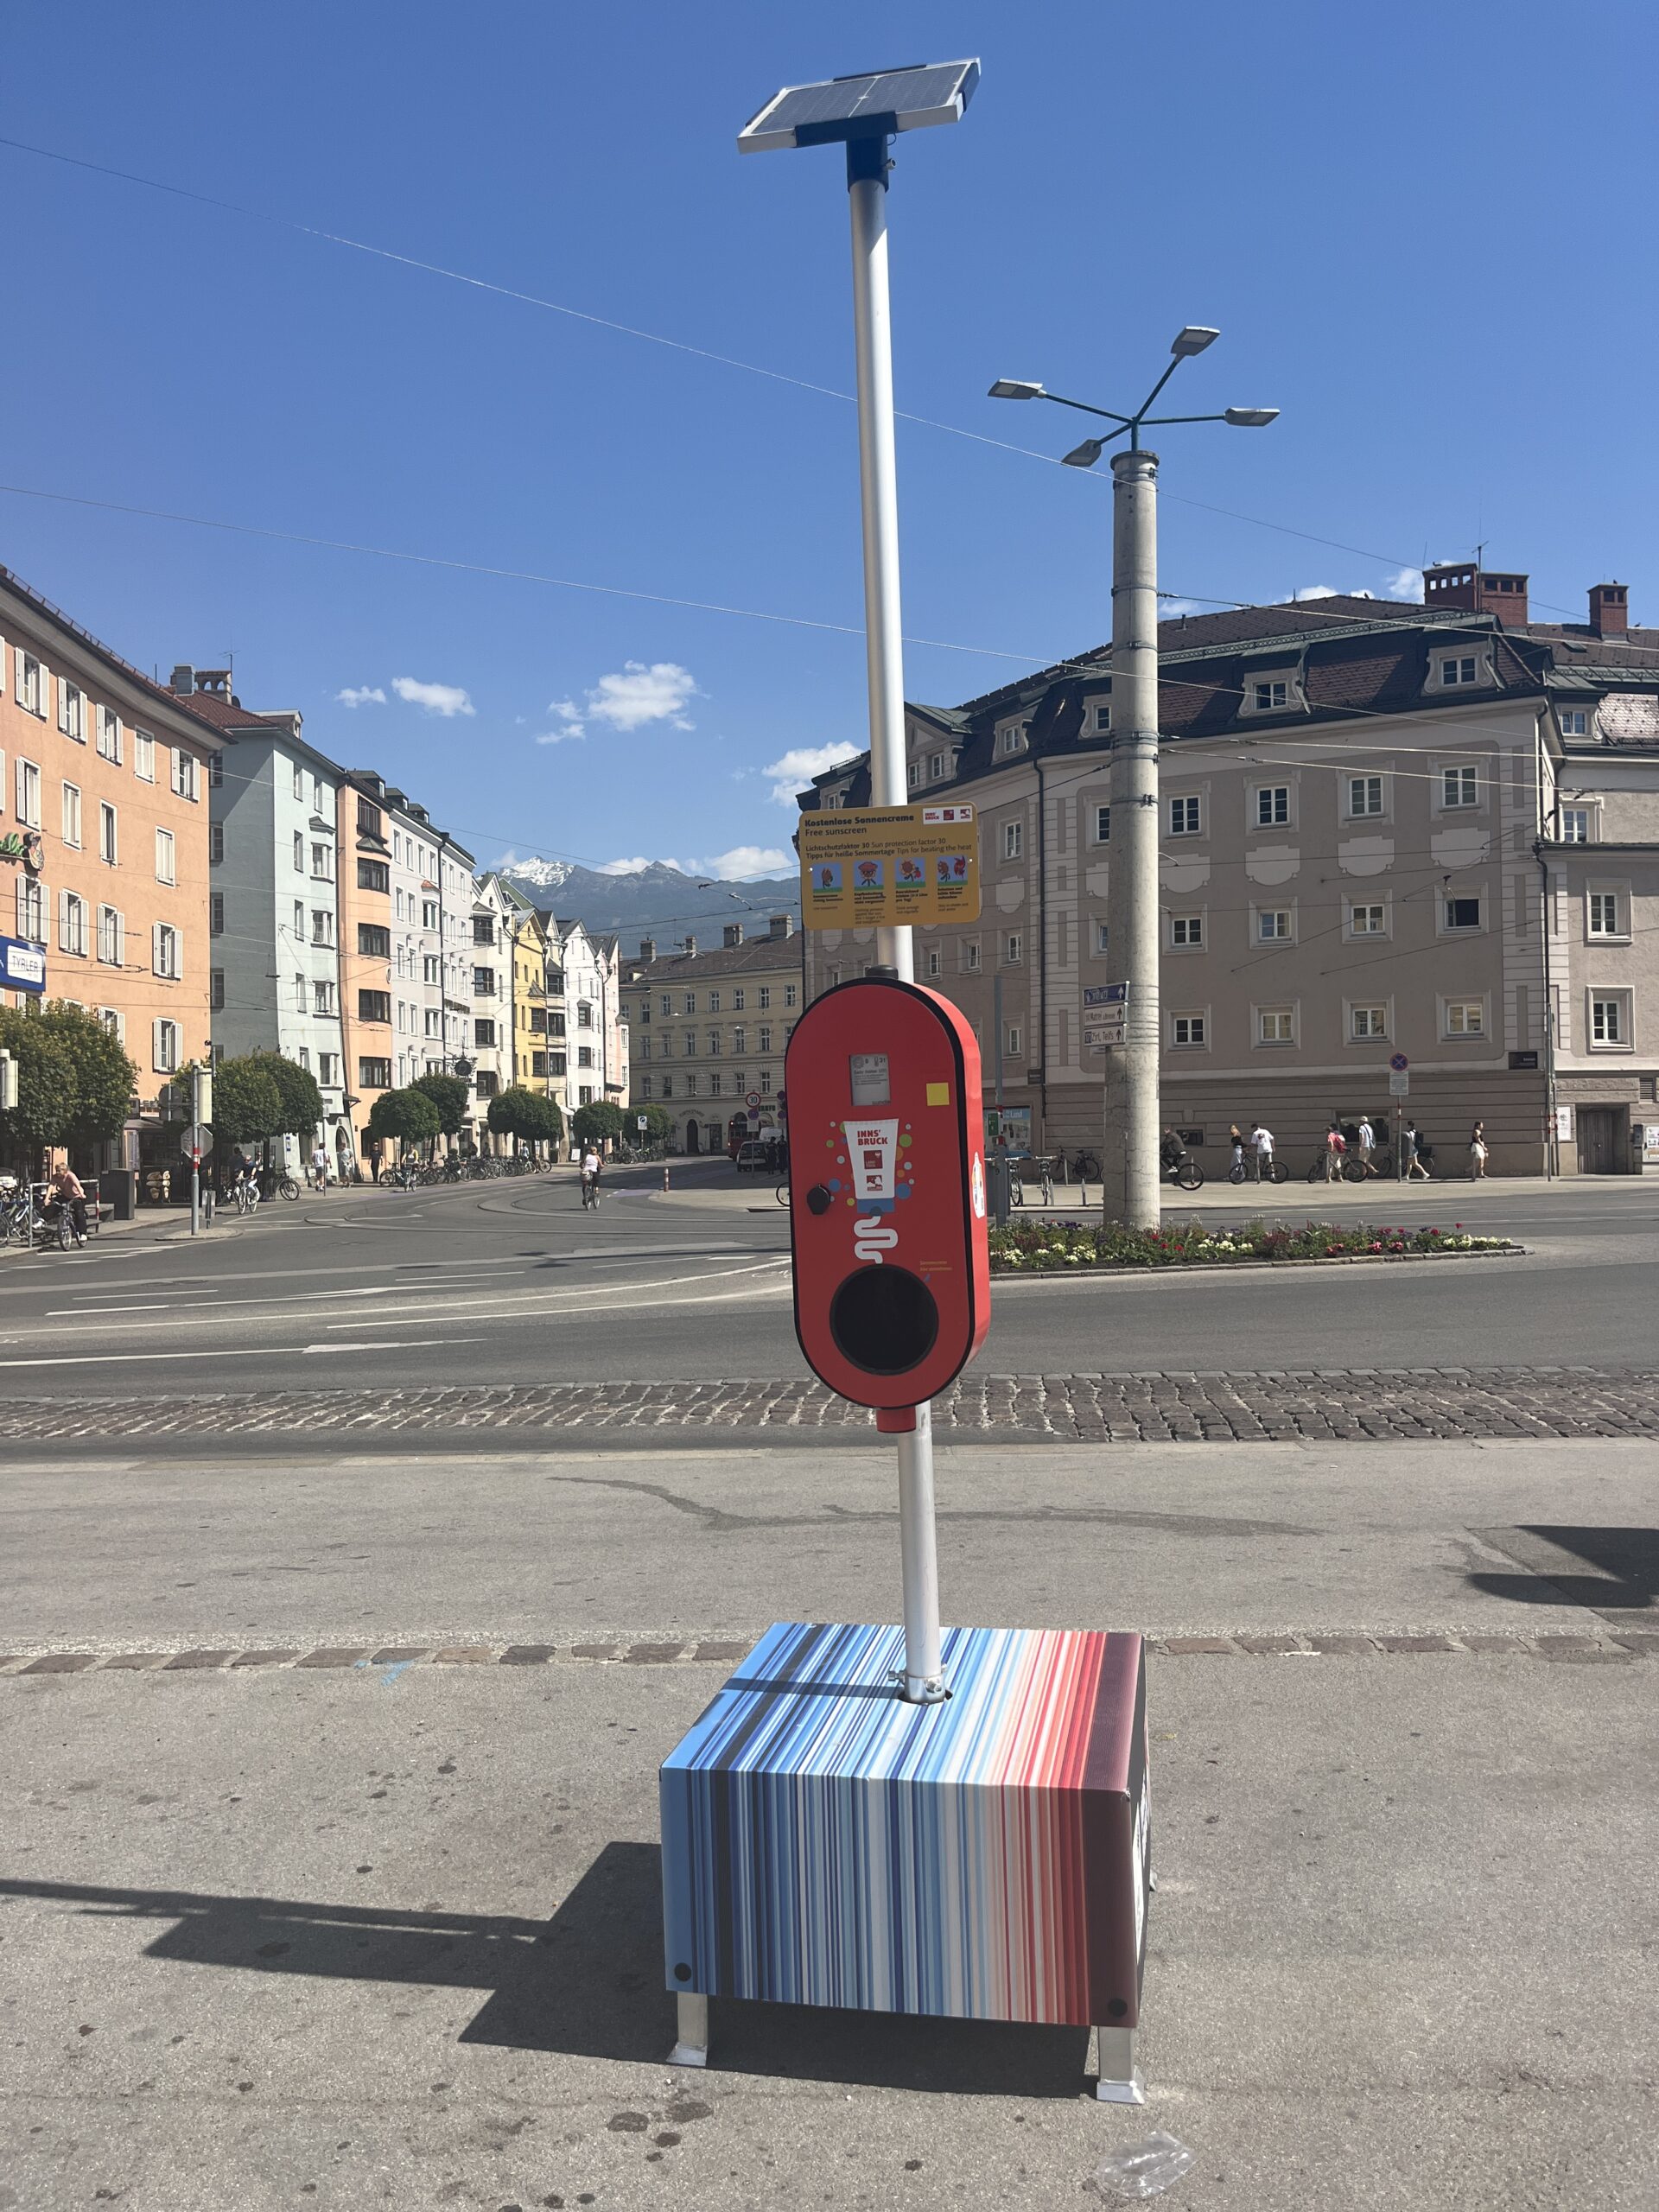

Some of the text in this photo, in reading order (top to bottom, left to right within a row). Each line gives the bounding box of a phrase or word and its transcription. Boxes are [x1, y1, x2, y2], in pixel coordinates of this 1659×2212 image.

[804, 815, 914, 826] Kostenlose Sonnencreme
[825, 827, 867, 836] sunscreen
[805, 842, 860, 852] Lichtschutzfaktor
[885, 839, 917, 848] protection
